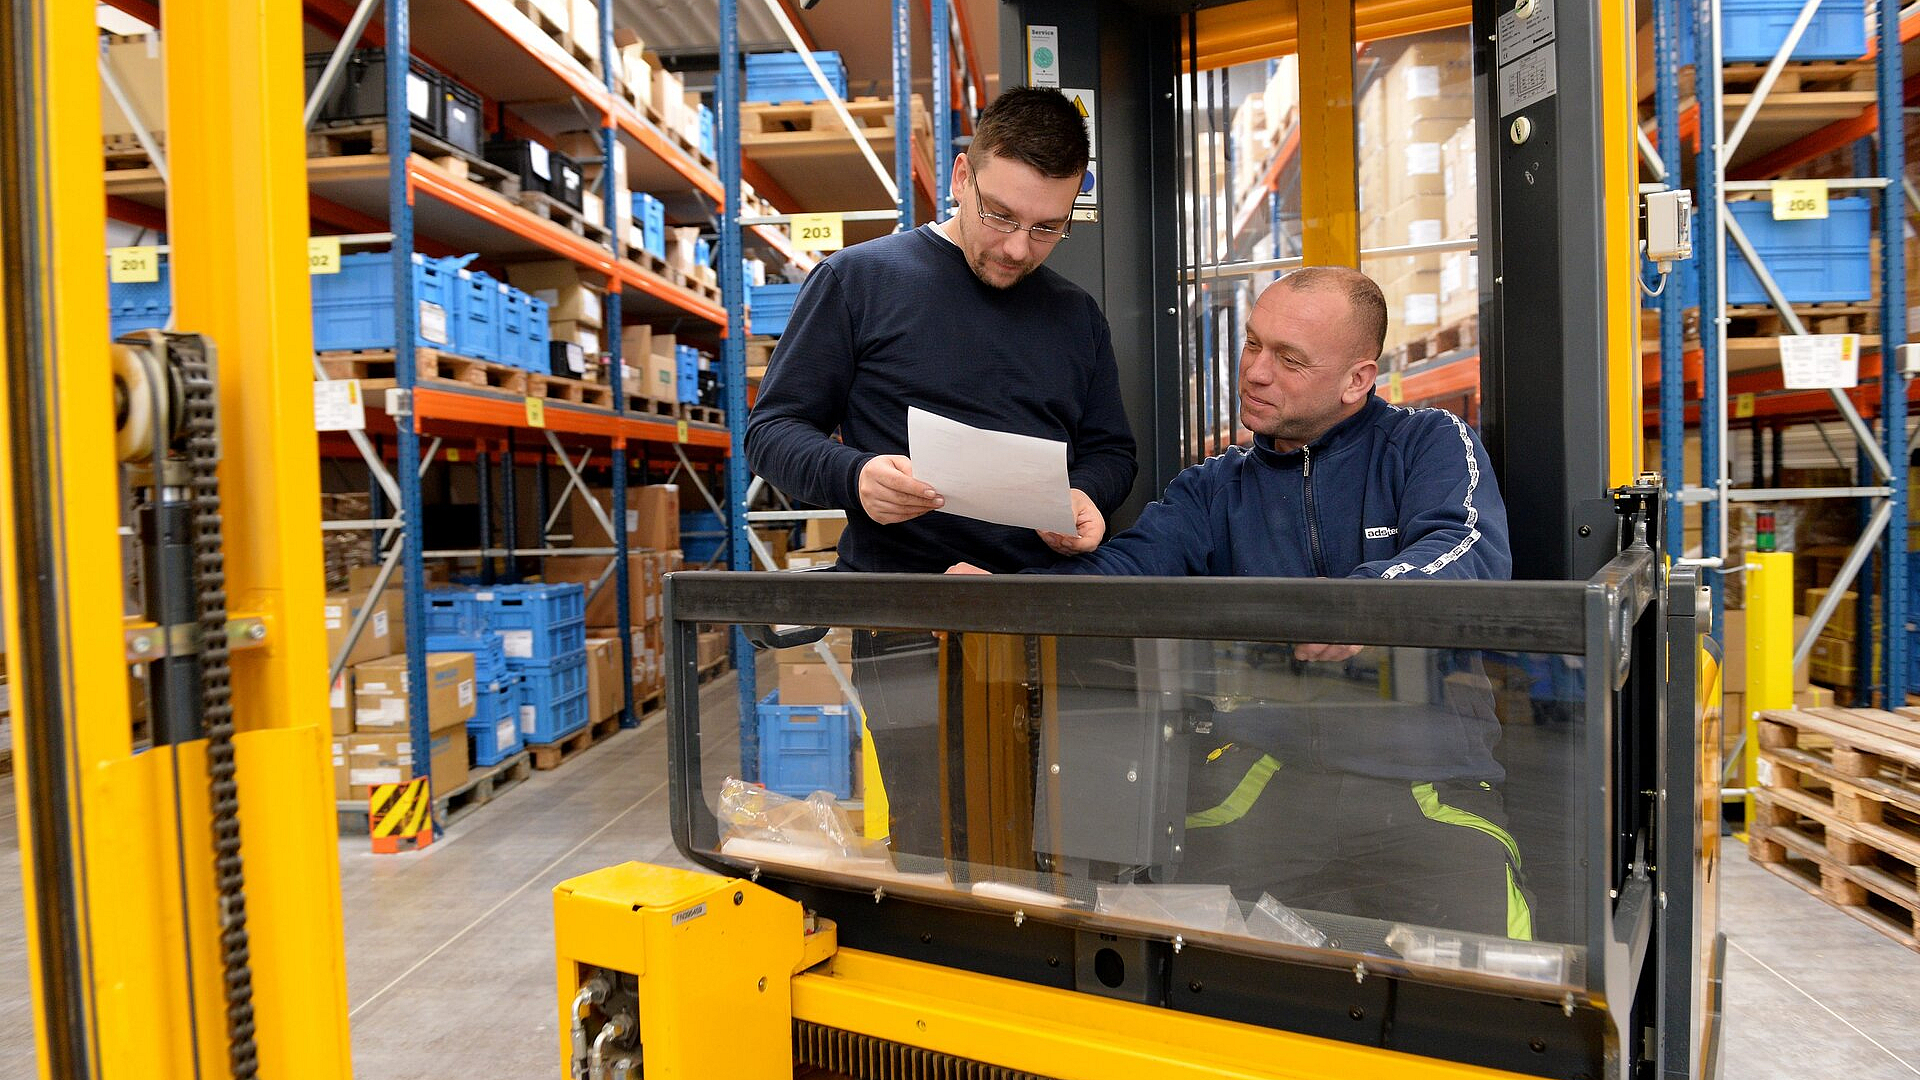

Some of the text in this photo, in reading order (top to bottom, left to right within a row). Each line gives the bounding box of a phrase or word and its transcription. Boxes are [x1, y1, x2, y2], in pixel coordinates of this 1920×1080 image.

[803, 227, 831, 239] 203
[121, 259, 146, 271] 201
[309, 255, 329, 267] 02
